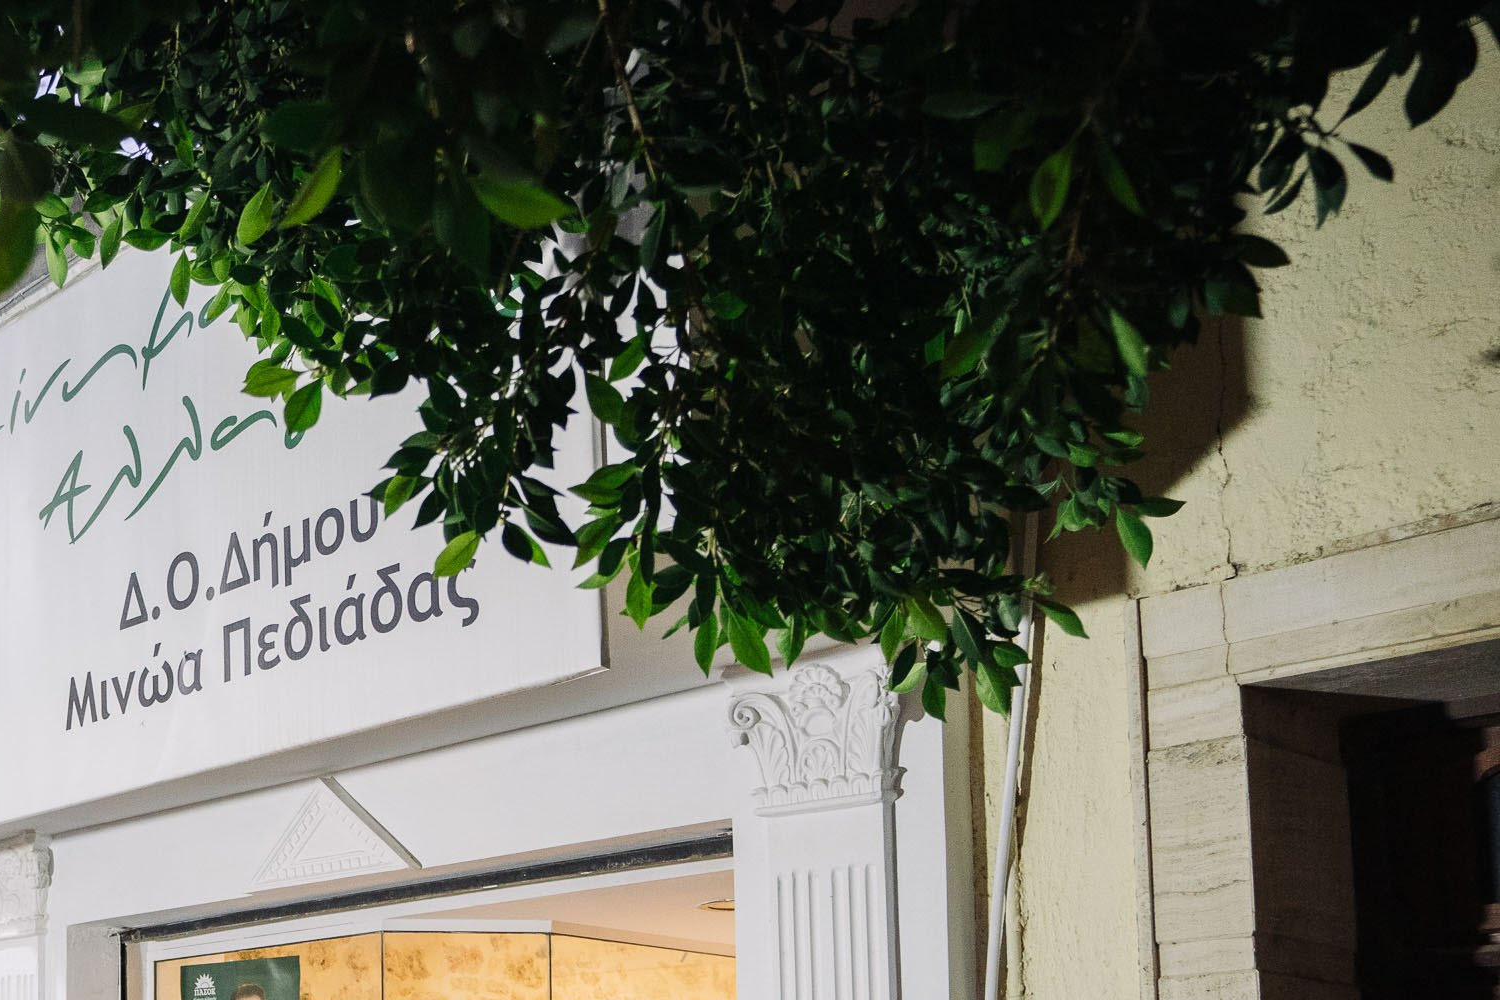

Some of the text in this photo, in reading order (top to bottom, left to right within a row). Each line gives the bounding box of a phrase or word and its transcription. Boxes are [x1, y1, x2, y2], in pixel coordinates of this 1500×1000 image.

[65, 558, 481, 731] Μινώα Πεδιάδας
[193, 987, 217, 997] ΠΑΣΟΚ
